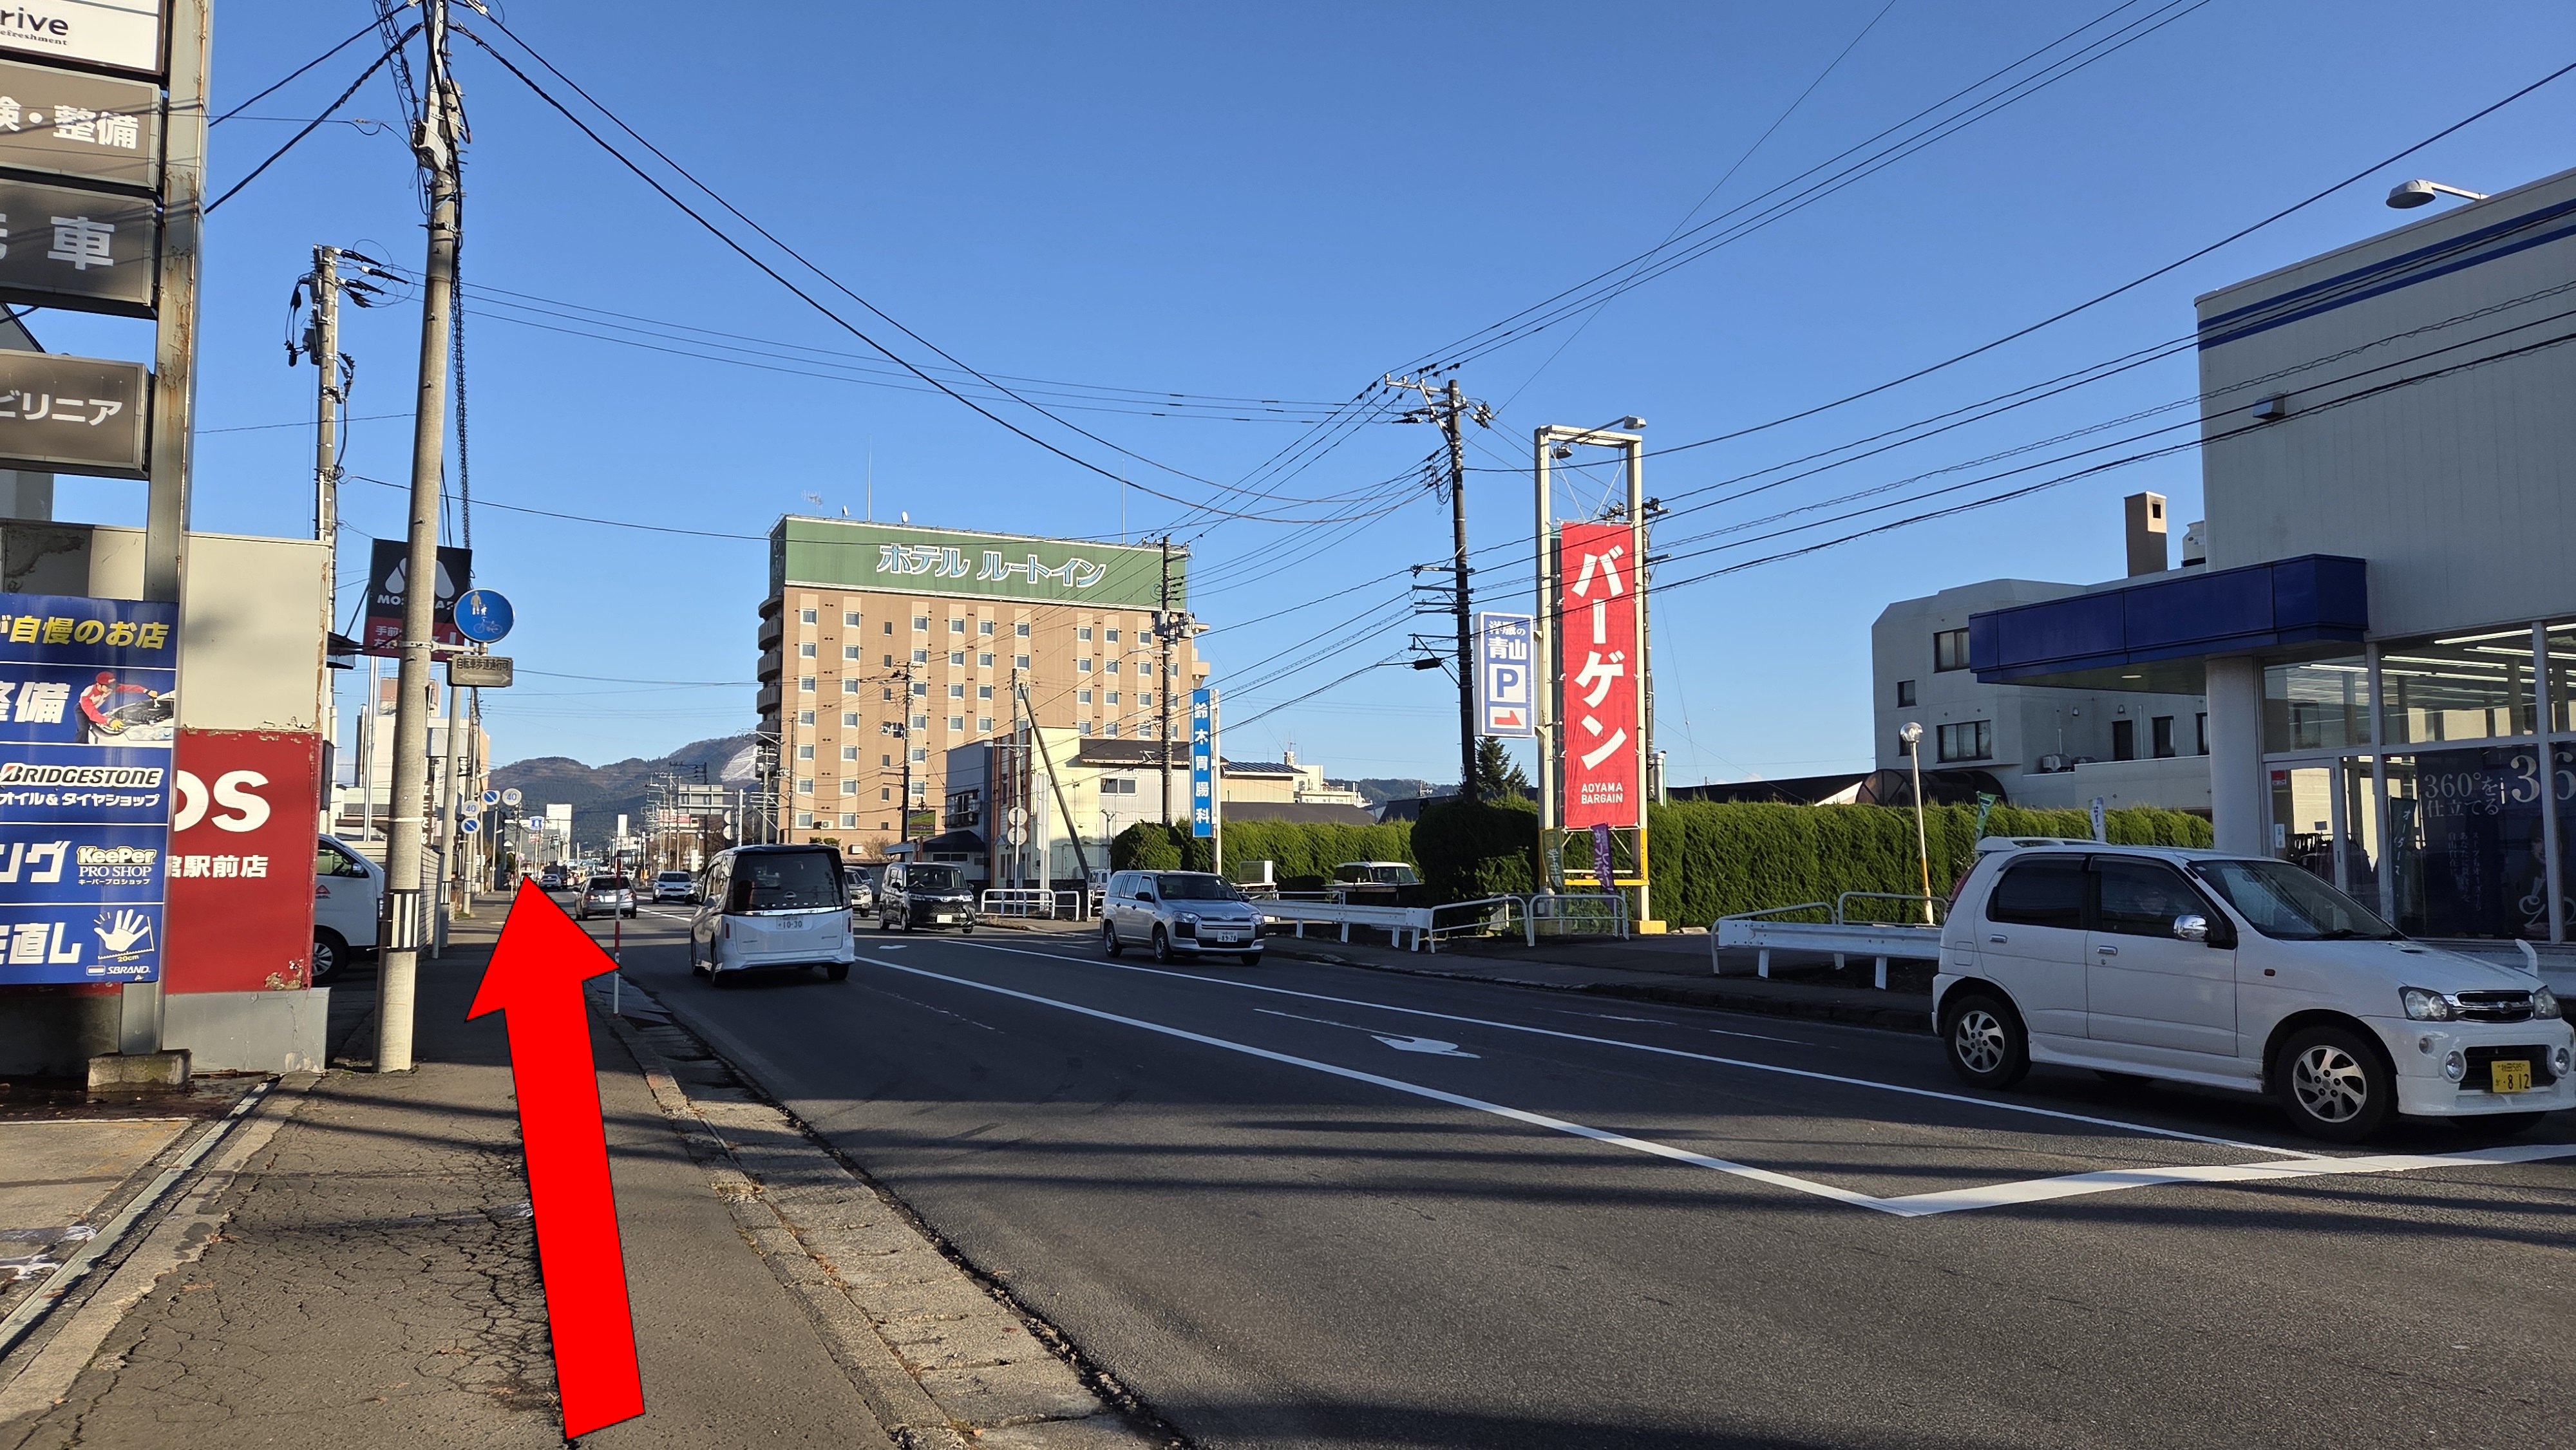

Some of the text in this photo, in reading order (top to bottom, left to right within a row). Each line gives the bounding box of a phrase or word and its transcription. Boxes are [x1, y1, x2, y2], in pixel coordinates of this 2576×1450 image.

[876, 543, 1107, 587] ホテル ルートイン
[1488, 636, 1528, 661] 青山
[1571, 545, 1627, 770] バーゲン
[1497, 668, 1519, 698] P
[0, 680, 71, 724] 備
[1193, 702, 1210, 824] 鈴木胃腸科
[1, 765, 160, 786] BRIDGESTONE
[506, 793, 517, 801] 40
[1581, 782, 1623, 793] AOYAMA
[466, 804, 477, 813] 40
[1581, 793, 1623, 804] BARGAIN
[2426, 798, 2499, 818] 仕立てる
[78, 846, 156, 864] KeePer
[79, 866, 152, 877] PRO SHOP
[0, 922, 82, 965] 直し
[117, 954, 140, 963] 20cm
